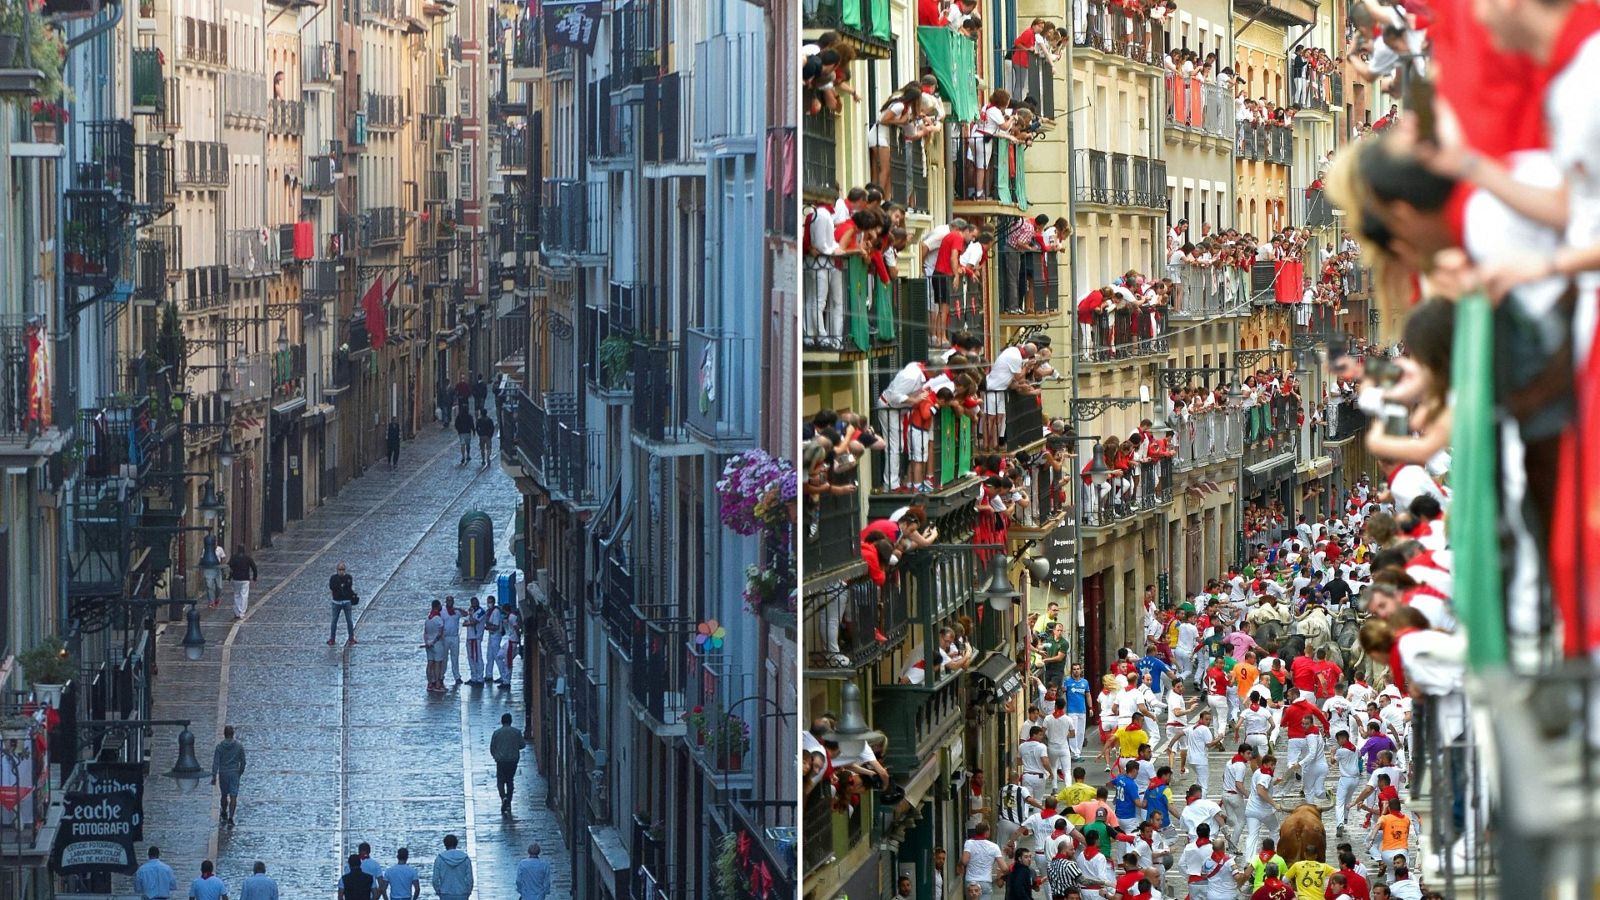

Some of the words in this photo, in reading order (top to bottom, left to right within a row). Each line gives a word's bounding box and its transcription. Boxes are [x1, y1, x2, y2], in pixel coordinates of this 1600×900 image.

[1240, 667, 1247, 680] 9
[1208, 676, 1217, 691] 12
[72, 822, 129, 836] FOTOGRAFO
[1302, 870, 1324, 887] 63
